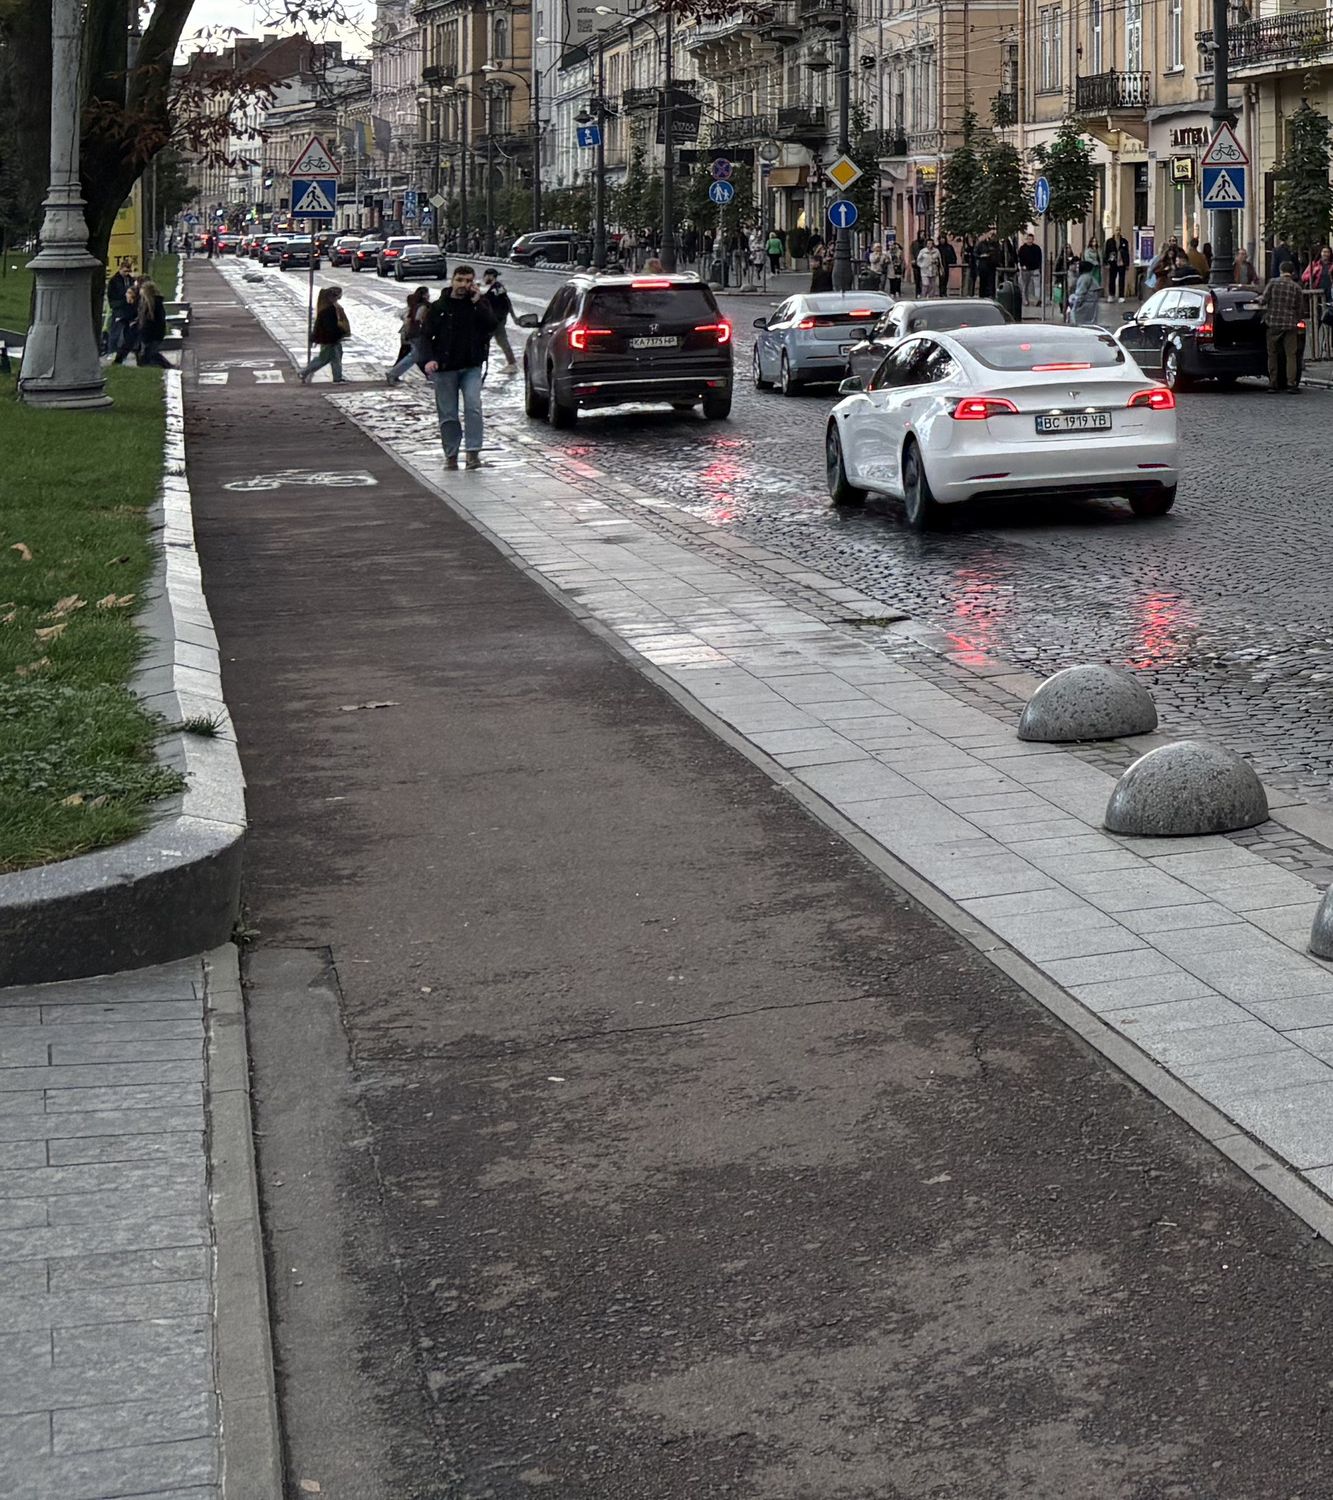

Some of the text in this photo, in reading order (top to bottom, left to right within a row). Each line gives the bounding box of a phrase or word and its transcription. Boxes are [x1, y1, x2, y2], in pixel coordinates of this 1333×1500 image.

[1044, 414, 1107, 429] BC 1919 YB
